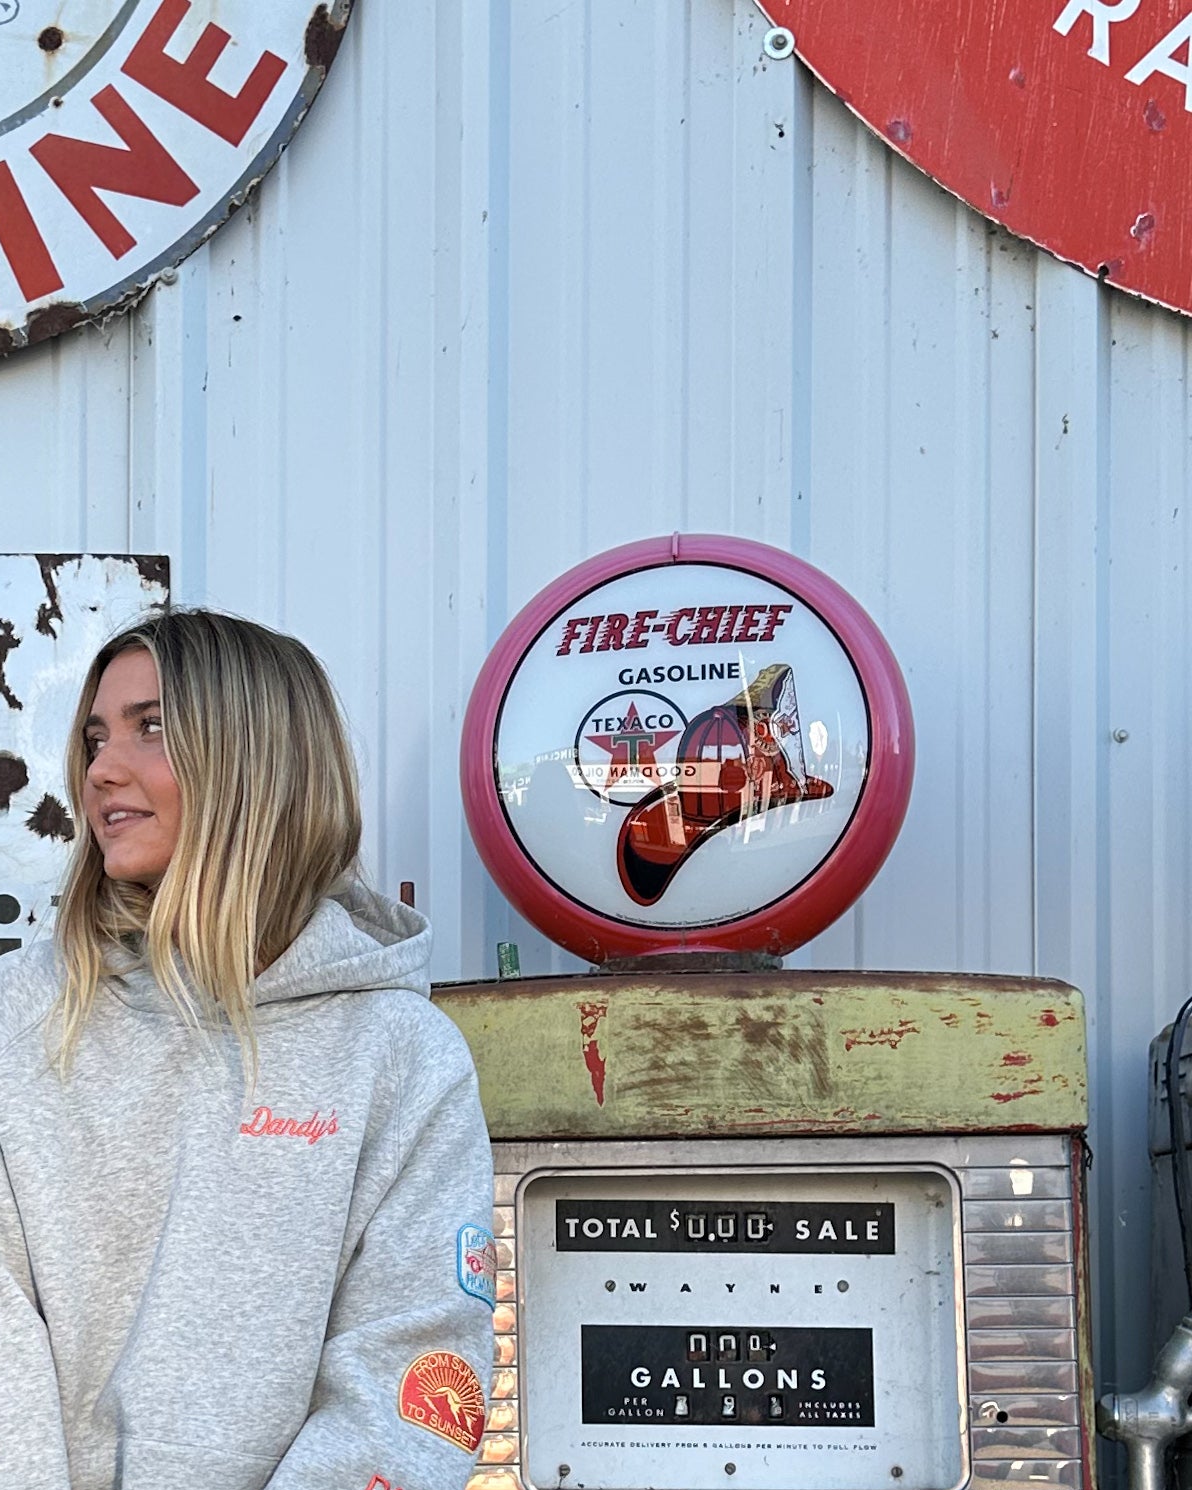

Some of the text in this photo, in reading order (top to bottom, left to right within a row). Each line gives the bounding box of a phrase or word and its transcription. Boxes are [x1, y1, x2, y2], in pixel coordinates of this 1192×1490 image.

[556, 605, 793, 657] FIRE-CHIEF
[618, 662, 740, 685] GASOLINE
[592, 714, 674, 733] TEXACO
[240, 1106, 339, 1145] Dandy's
[565, 1217, 657, 1240] TOTAL
[795, 1220, 880, 1241] SALE
[629, 1282, 823, 1294] WAYNE
[413, 1354, 450, 1379] FROM
[630, 1367, 827, 1391] GALLONS
[608, 1407, 665, 1417] GALLON
[624, 1397, 649, 1407] PER
[799, 1401, 861, 1410] INCLUDES
[407, 1402, 477, 1448] TO SUNSET
[799, 1410, 861, 1420] ALL TAXES
